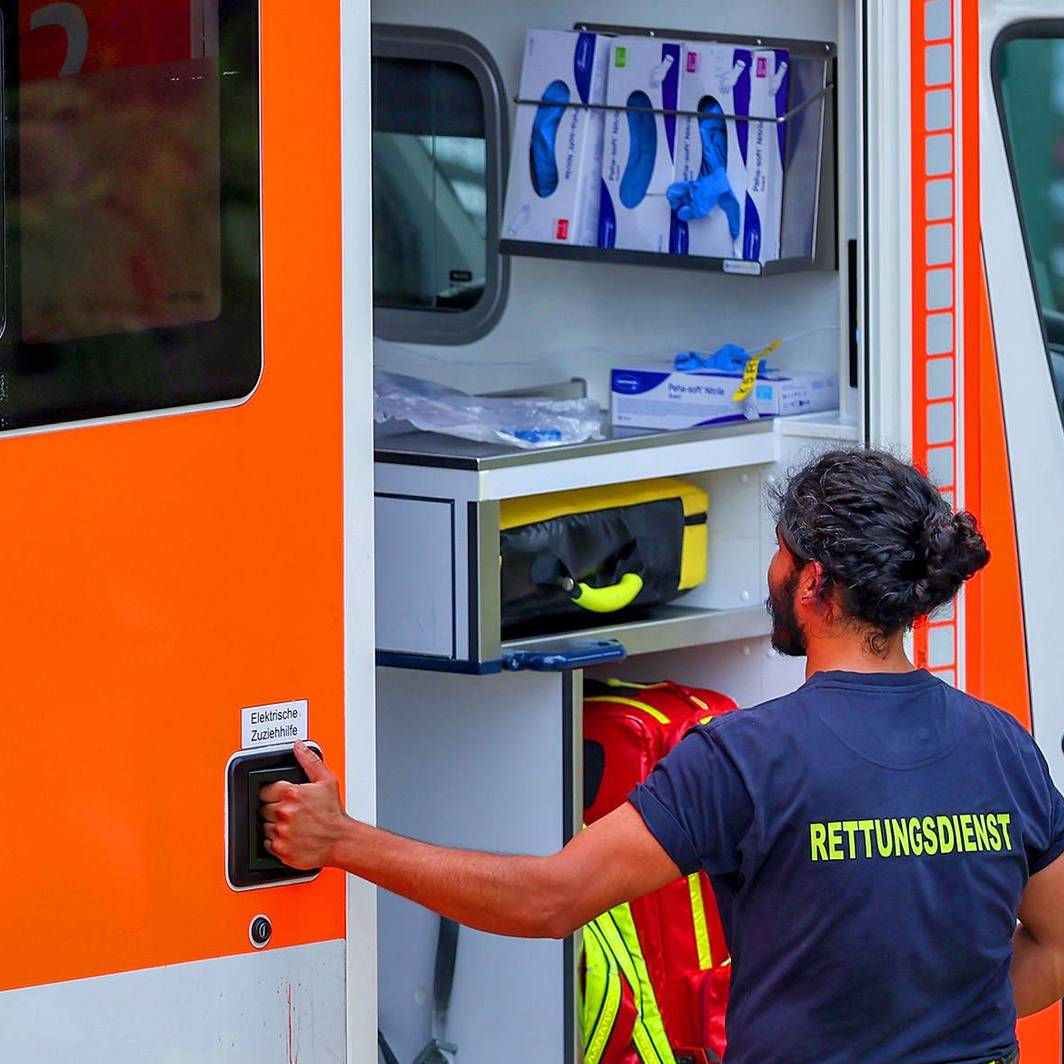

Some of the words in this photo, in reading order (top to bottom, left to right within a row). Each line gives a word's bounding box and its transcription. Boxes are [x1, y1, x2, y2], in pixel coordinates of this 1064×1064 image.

[250, 708, 298, 724] Elektrische
[250, 725, 298, 742] Zuziehhilfe
[809, 813, 1012, 861] RETTUNGSDIENST
